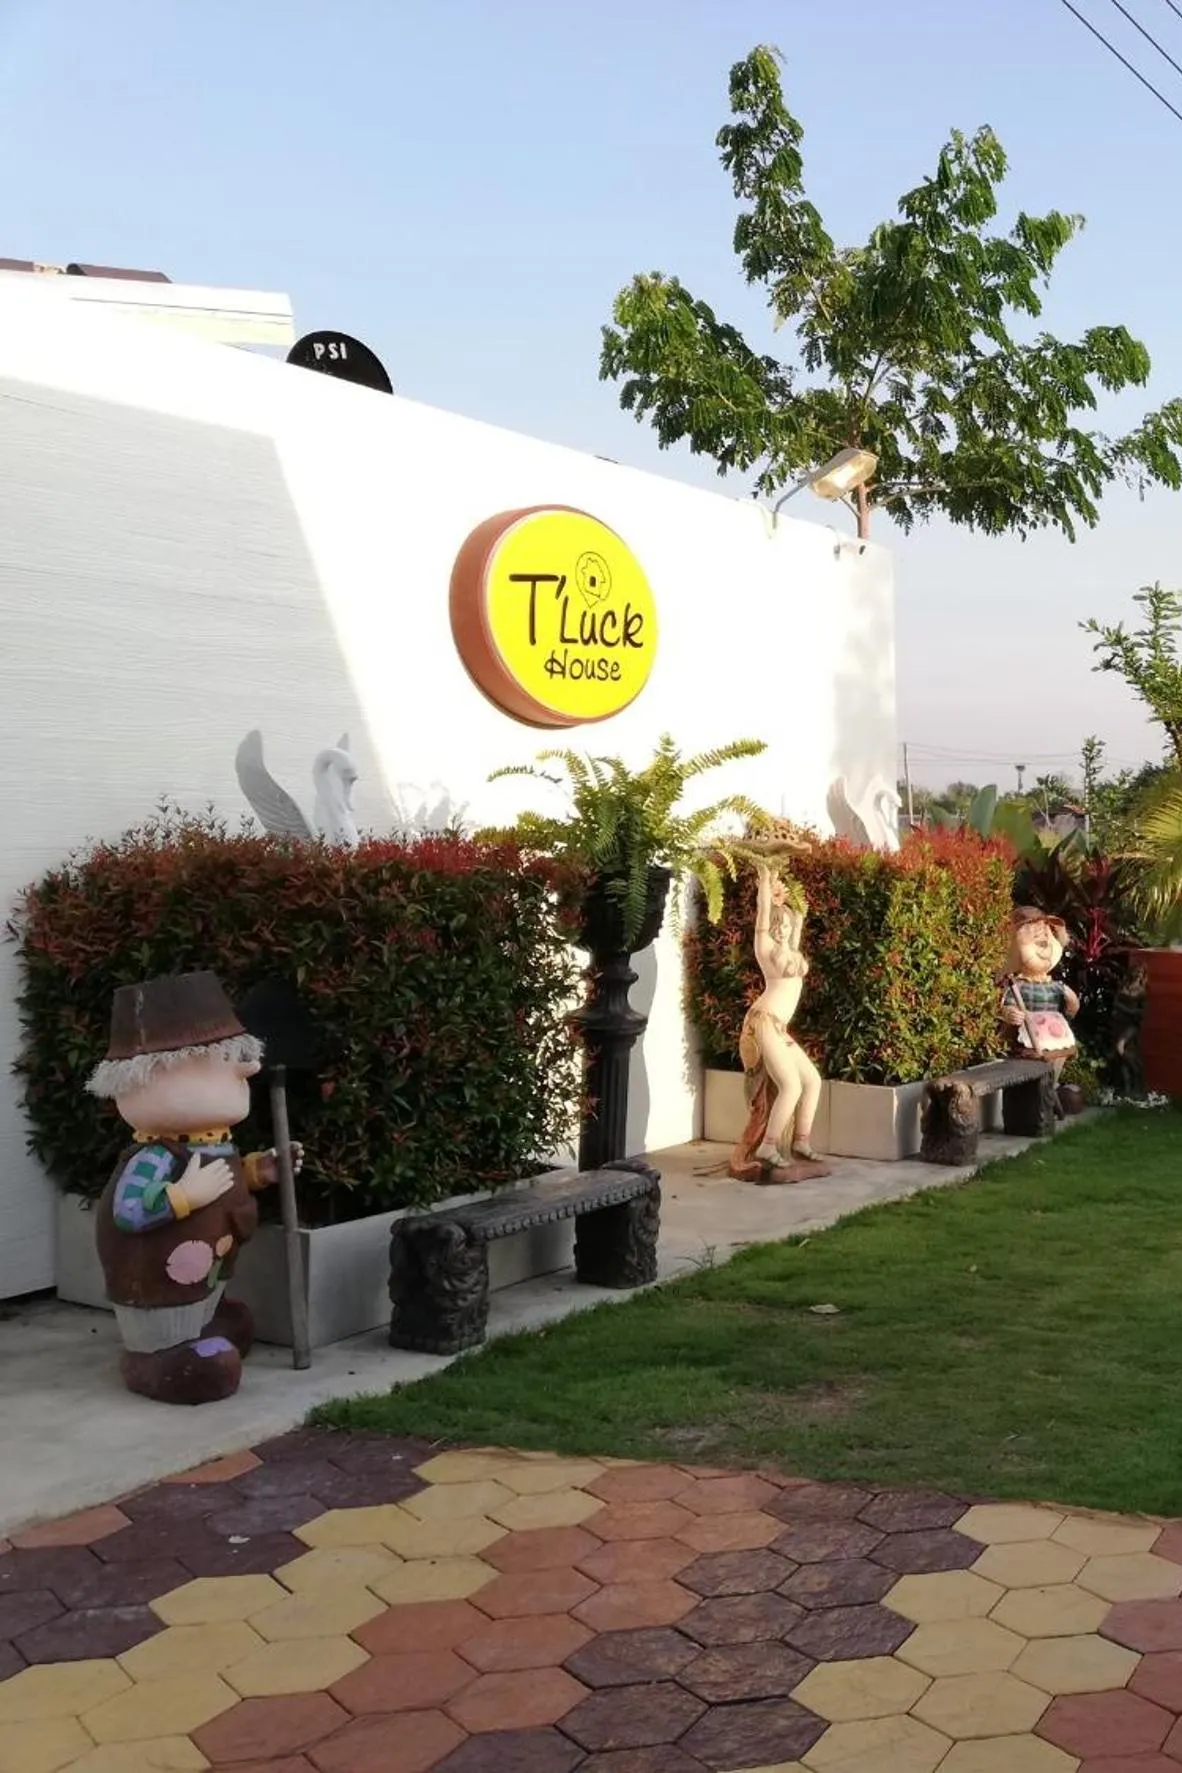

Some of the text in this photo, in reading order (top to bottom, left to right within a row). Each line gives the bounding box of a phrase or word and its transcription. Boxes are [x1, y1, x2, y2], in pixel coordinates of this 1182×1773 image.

[313, 342, 347, 360] PSI
[509, 573, 644, 648] T'Luck
[543, 648, 622, 681] House
